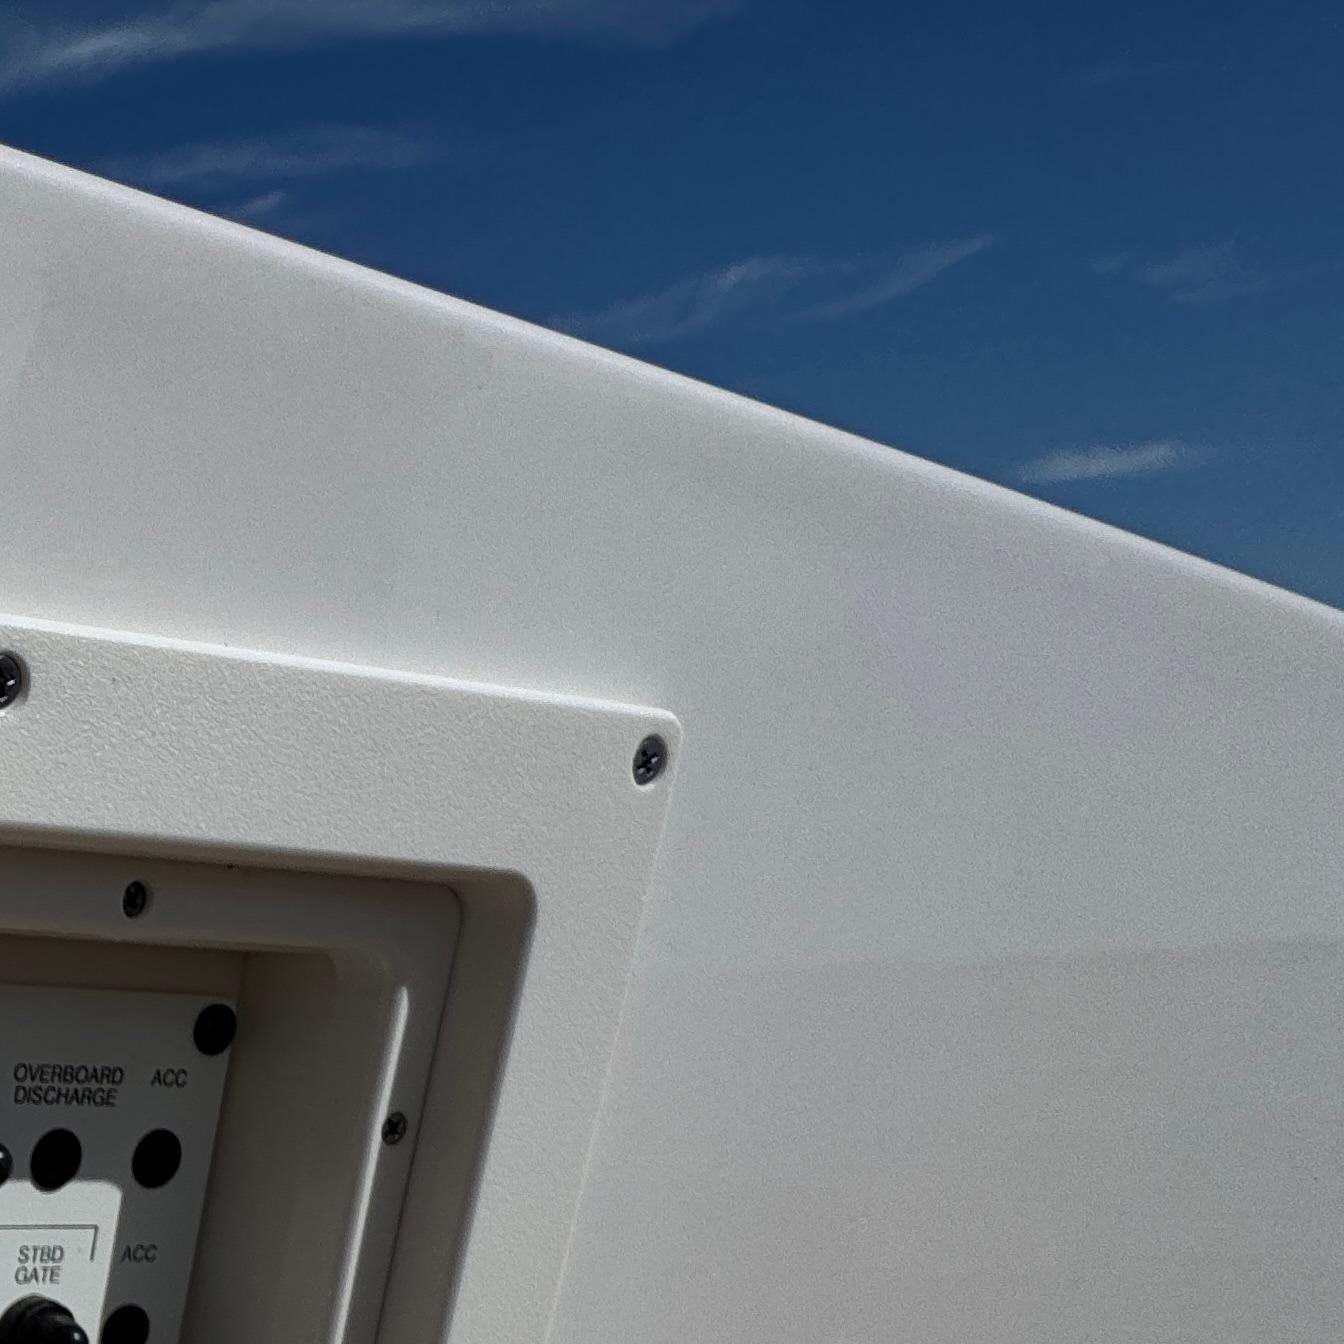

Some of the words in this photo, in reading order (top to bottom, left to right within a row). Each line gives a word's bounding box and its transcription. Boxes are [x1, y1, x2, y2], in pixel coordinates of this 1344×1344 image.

[13, 1063, 124, 1086] OVERBOARD
[151, 1068, 188, 1089] ACC
[14, 1084, 118, 1107] DISCHARGE
[17, 1245, 64, 1264] STBD
[121, 1244, 157, 1264] ACC
[14, 1264, 61, 1285] GATE
